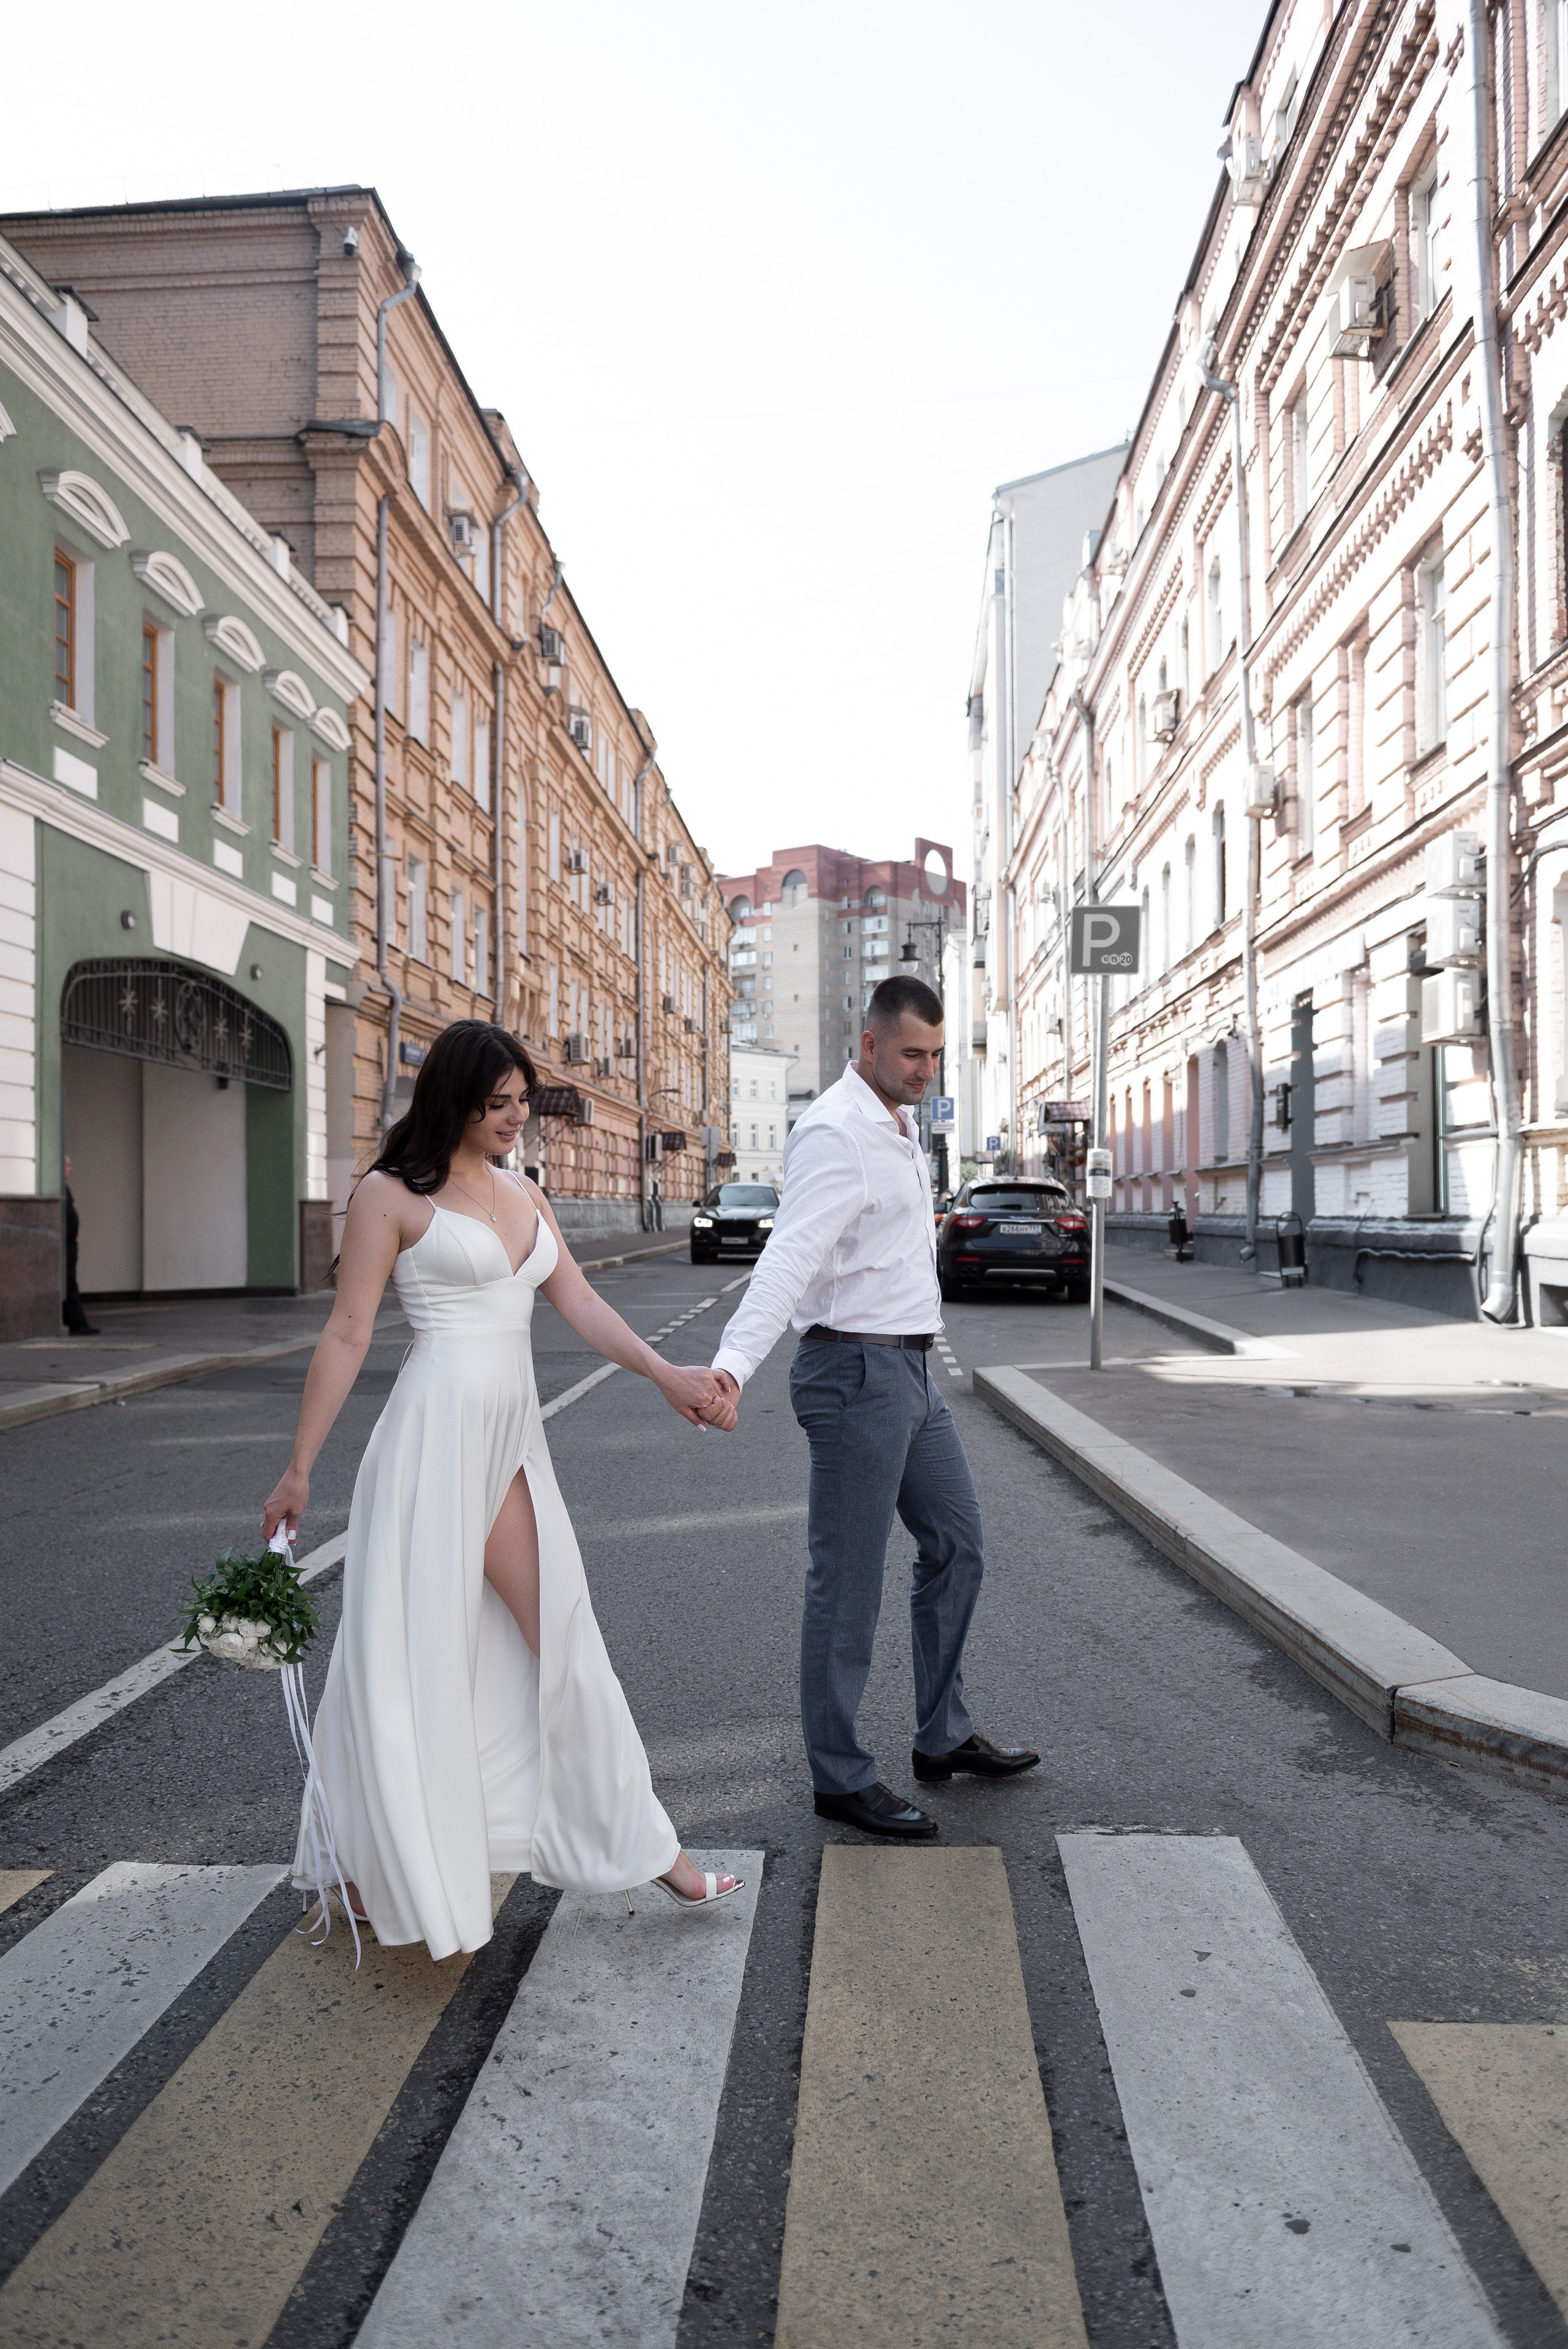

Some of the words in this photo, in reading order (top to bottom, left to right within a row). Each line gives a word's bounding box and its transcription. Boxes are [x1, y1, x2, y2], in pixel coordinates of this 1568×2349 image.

[1082, 913, 1120, 967] P
[938, 1099, 952, 1118] P
[989, 1137, 998, 1150] P
